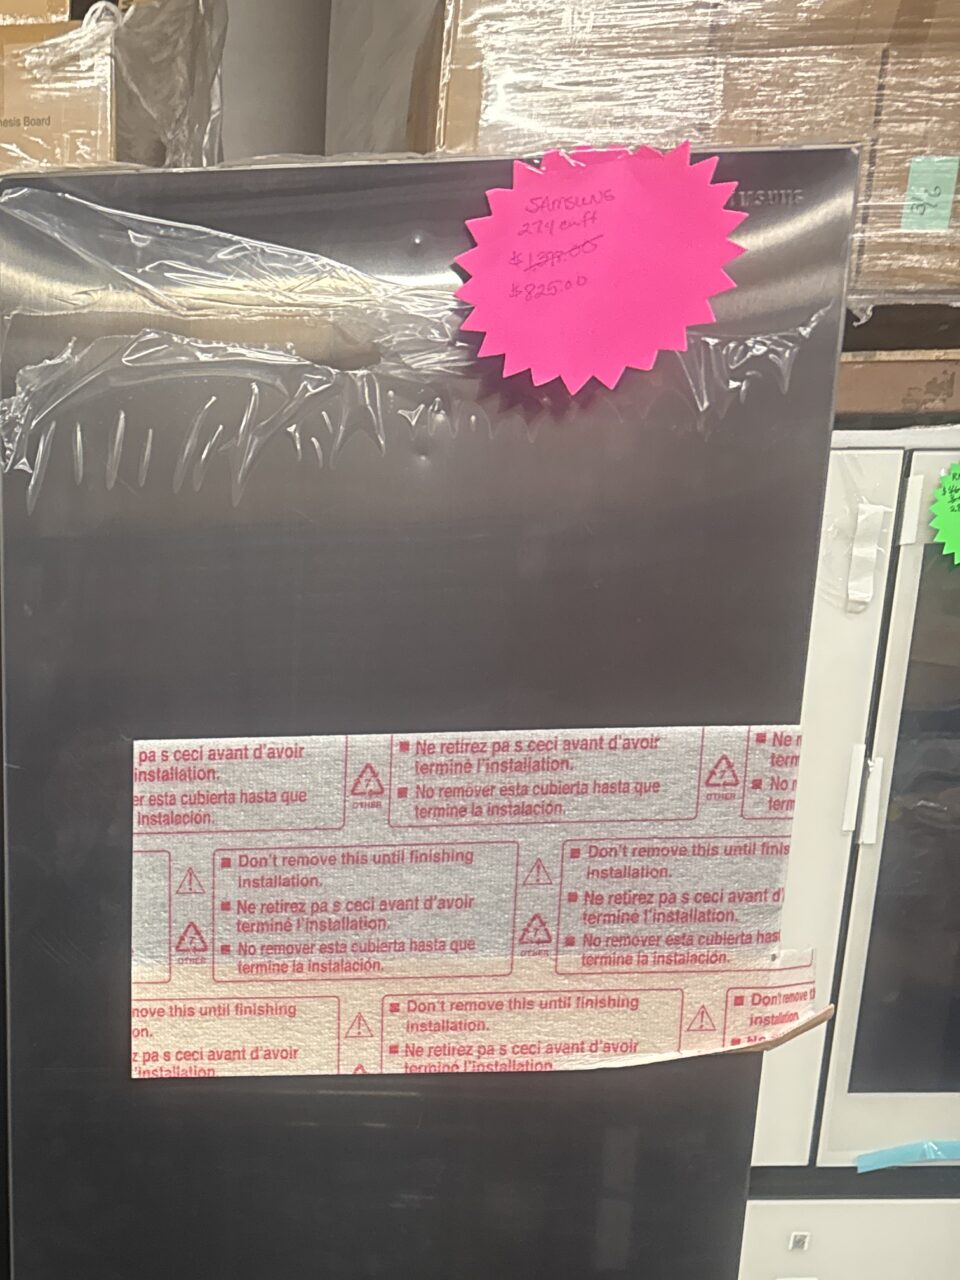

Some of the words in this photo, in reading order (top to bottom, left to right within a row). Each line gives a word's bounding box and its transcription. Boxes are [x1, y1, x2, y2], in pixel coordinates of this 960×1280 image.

[23, 115, 51, 127] Board
[415, 740, 436, 755] Ne
[439, 739, 487, 754] retirez
[527, 737, 558, 752] ceci
[562, 736, 604, 752] avant
[607, 735, 660, 751] d'avoir
[415, 759, 473, 774] terminé
[415, 784, 435, 798] No
[438, 785, 496, 798] remover
[499, 782, 529, 797] esta
[532, 781, 588, 796] cubierta
[592, 780, 630, 795] hasta
[633, 782, 660, 798] que
[414, 803, 468, 818] termine
[470, 803, 483, 817] la
[486, 802, 566, 817] instalación.
[238, 852, 277, 867] Don't
[282, 854, 336, 866] remove
[341, 850, 368, 865] this
[372, 850, 405, 865] until
[409, 848, 474, 867] finishing
[238, 875, 322, 888] installation.
[406, 998, 445, 1012] Don't
[449, 1000, 504, 1011] remove
[507, 997, 534, 1010] this
[538, 996, 571, 1009] until
[575, 995, 640, 1012] finishing
[405, 1019, 490, 1032] installation.
